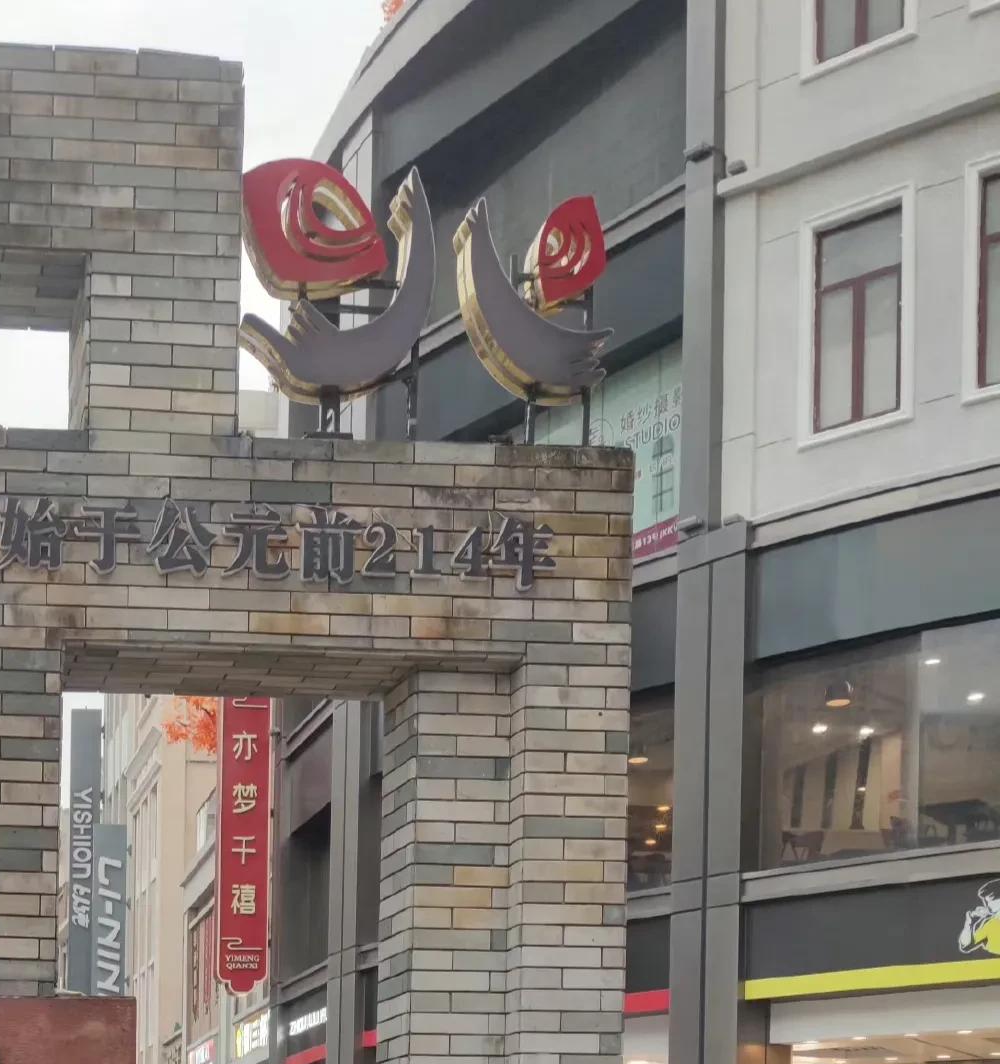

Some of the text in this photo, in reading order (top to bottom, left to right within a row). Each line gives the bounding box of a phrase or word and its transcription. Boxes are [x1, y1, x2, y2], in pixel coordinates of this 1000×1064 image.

[624, 412, 681, 449] STUDIO
[0, 497, 557, 592] 始于公元前214年
[72, 786, 94, 880] YISHION
[231, 730, 259, 916] 亦梦千禧
[96, 855, 123, 996] LI-NIN
[225, 954, 260, 963] YIMENG
